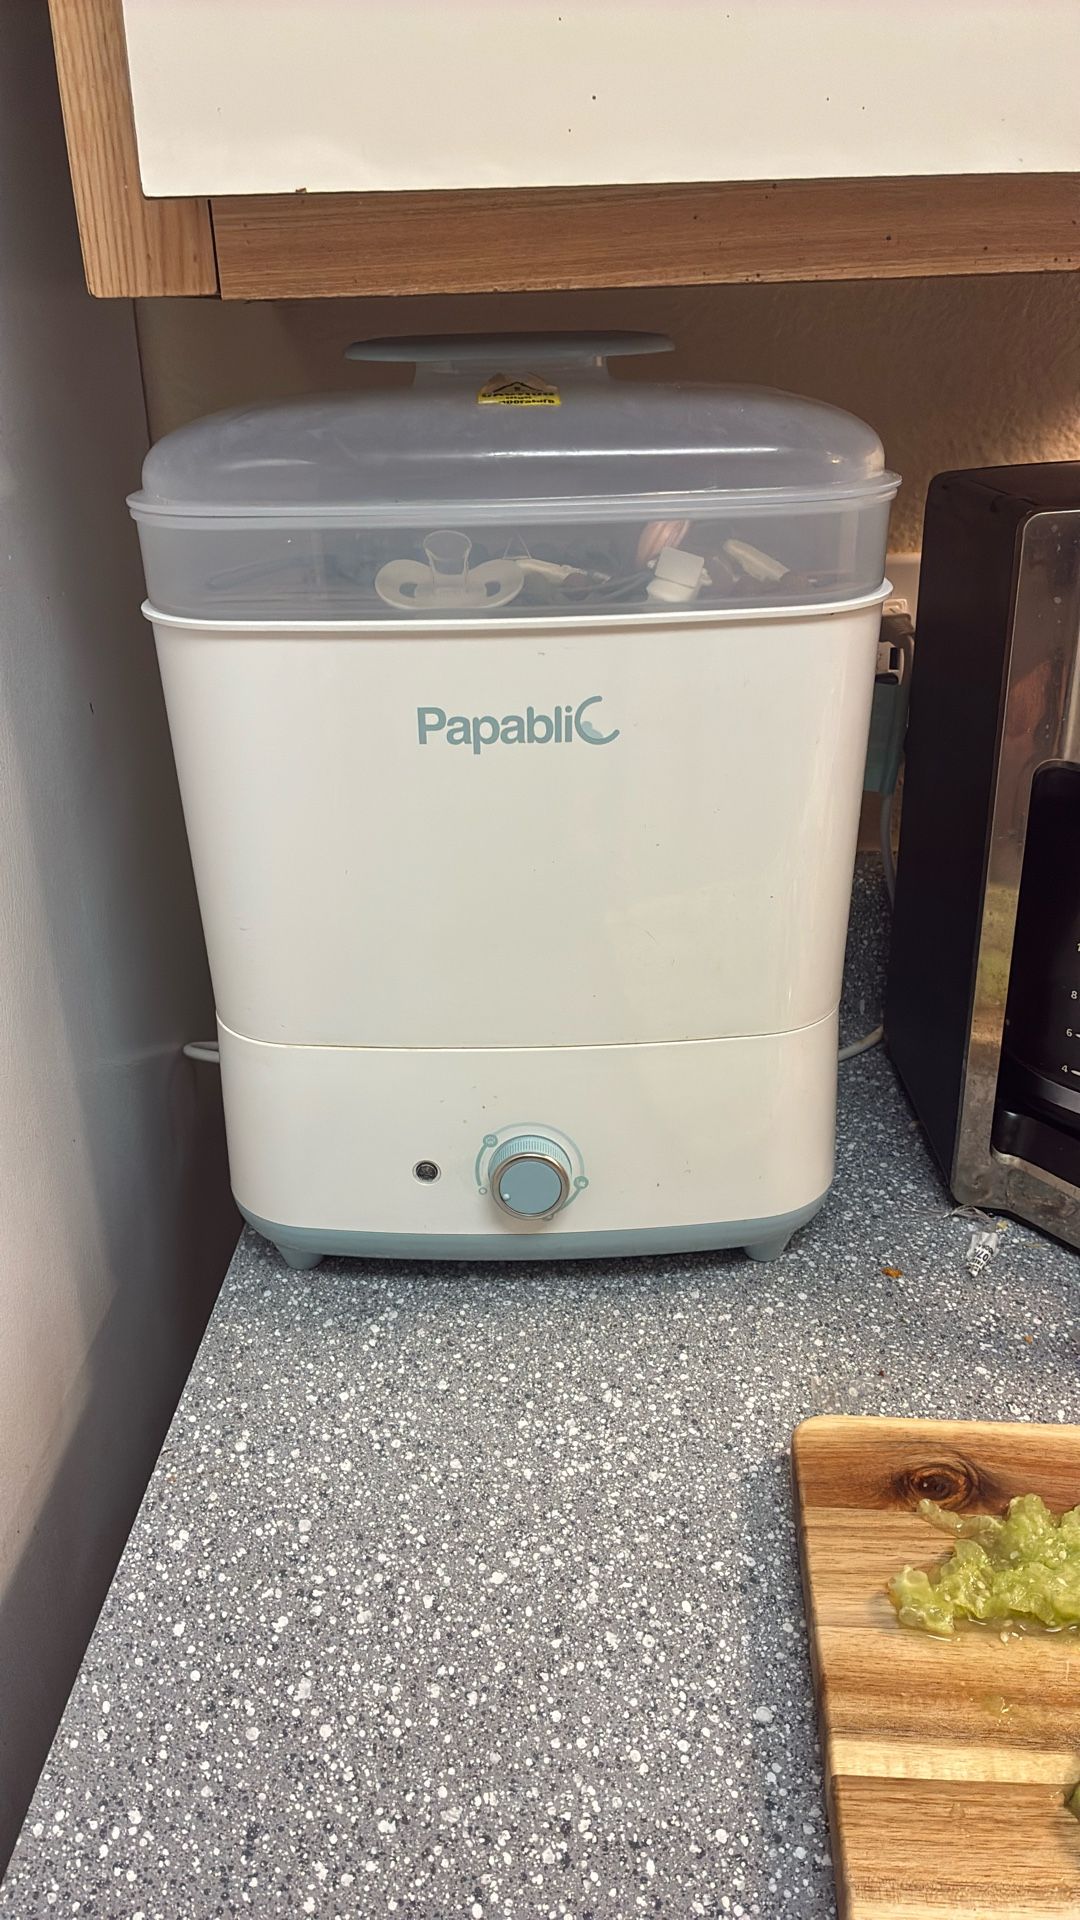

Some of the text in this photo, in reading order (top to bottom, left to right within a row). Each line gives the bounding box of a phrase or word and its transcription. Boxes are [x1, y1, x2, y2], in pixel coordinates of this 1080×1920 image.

[1070, 990, 1078, 1000] 8
[1065, 1028, 1073, 1037] 6
[1061, 1065, 1068, 1073] 4
